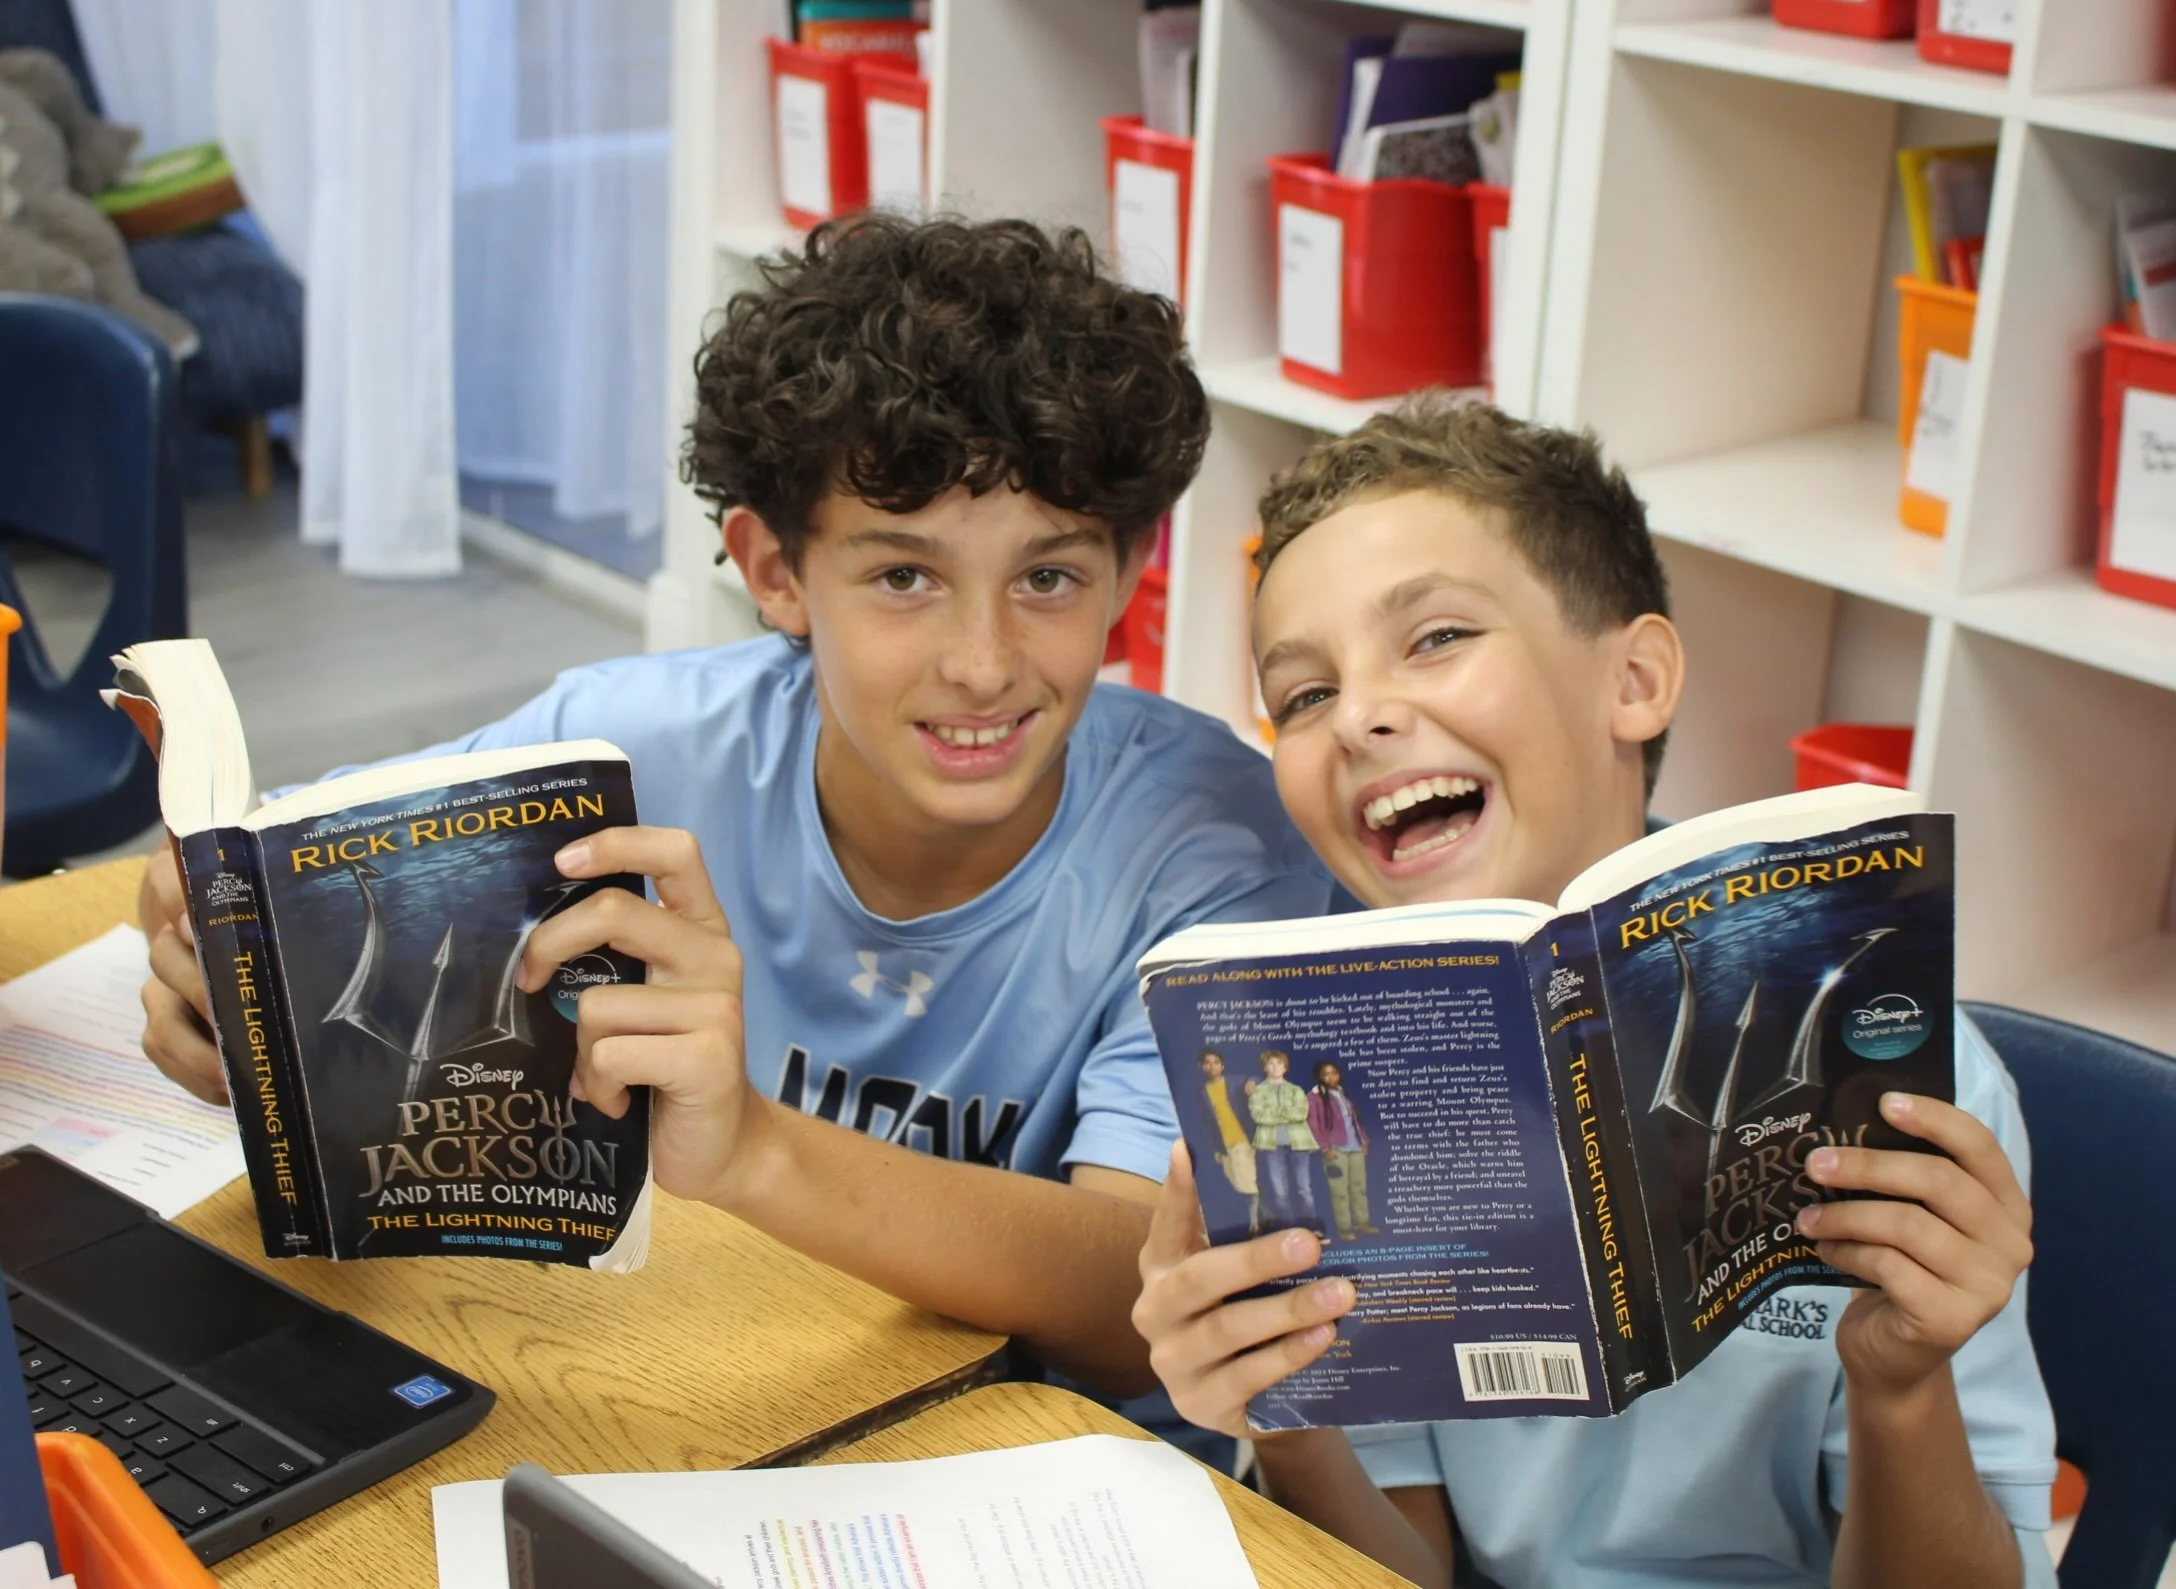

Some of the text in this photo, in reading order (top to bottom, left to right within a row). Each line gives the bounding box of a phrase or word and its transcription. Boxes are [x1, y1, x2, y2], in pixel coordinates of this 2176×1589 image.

[302, 777, 589, 842] THE NEW YORK TIMES #1 BEST-SELLING SERIES
[290, 793, 605, 874] RICK RIORDAN
[217, 848, 225, 862] 1
[1630, 899, 1653, 912] THE
[1654, 885, 1680, 902] NEW
[1680, 873, 1713, 890] YORK
[1714, 861, 1752, 877] TIMES
[1768, 838, 1860, 863] BEST-SELLING
[1860, 830, 1910, 846] SERIES
[206, 883, 253, 900] JACKSON
[1619, 845, 1924, 949] RICK RIORDAN
[1550, 941, 1559, 957] 1
[233, 951, 256, 1002] THE
[1165, 955, 1499, 988] READ ALONG WITH THE LIVE-ACTION SERIES!
[1550, 1008, 1594, 1034] RIORDAN
[1852, 1023, 1923, 1039] Original series
[244, 1007, 283, 1134] LIGHTNING
[440, 1062, 525, 1091] Disney
[1389, 1063, 1505, 1078] Percy and his friends have just
[397, 1087, 577, 1138] PERCY
[1733, 1112, 1812, 1147] Disney
[264, 1137, 298, 1206] THIEF
[358, 1133, 620, 1198] JACKSON
[1456, 1179, 1529, 1192] powerful than the
[1568, 1053, 1634, 1341] THE LIGHTNING THIEF
[377, 1183, 618, 1216] AND THE OLYMPIANS
[367, 1211, 617, 1242] THE LIGHTNING THIEF
[1392, 1222, 1501, 1235] must-have for your library.
[1683, 1172, 1822, 1303] JACKS
[441, 1234, 563, 1251] INCLUDES PHOTOS FROM THE SERIES!
[1416, 1243, 1452, 1253] INSERT
[1453, 1243, 1468, 1251] OF
[1357, 1254, 1399, 1265] PHOTOS
[1400, 1252, 1427, 1262] FROM
[1429, 1251, 1450, 1260] THE
[1450, 1250, 1490, 1260] SERIES!
[1696, 1262, 1730, 1306] AND
[1732, 1232, 1769, 1270] THE
[1784, 1265, 1805, 1277] FROM
[1377, 1271, 1408, 1282] moments
[1409, 1269, 1437, 1279] chasing
[1438, 1268, 1456, 1277] each
[1457, 1266, 1476, 1275] other
[1477, 1266, 1490, 1275] like
[1373, 1285, 1458, 1298] and breakneck pace will
[1472, 1285, 1491, 1296] keep
[1491, 1284, 1506, 1293] kids
[1691, 1245, 1821, 1334] THE LIGHTNIN
[1390, 1305, 1409, 1315] meet
[1409, 1305, 1429, 1315] Percy
[1429, 1304, 1460, 1313] Jackson,
[1471, 1303, 1497, 1313] legions
[1506, 1302, 1523, 1311] fans
[1523, 1302, 1551, 1312] already
[1757, 1296, 1829, 1323] ARK'S
[1515, 1332, 1528, 1340] US
[1559, 1333, 1578, 1341] CAN
[1759, 1316, 1827, 1341] SCHOOL
